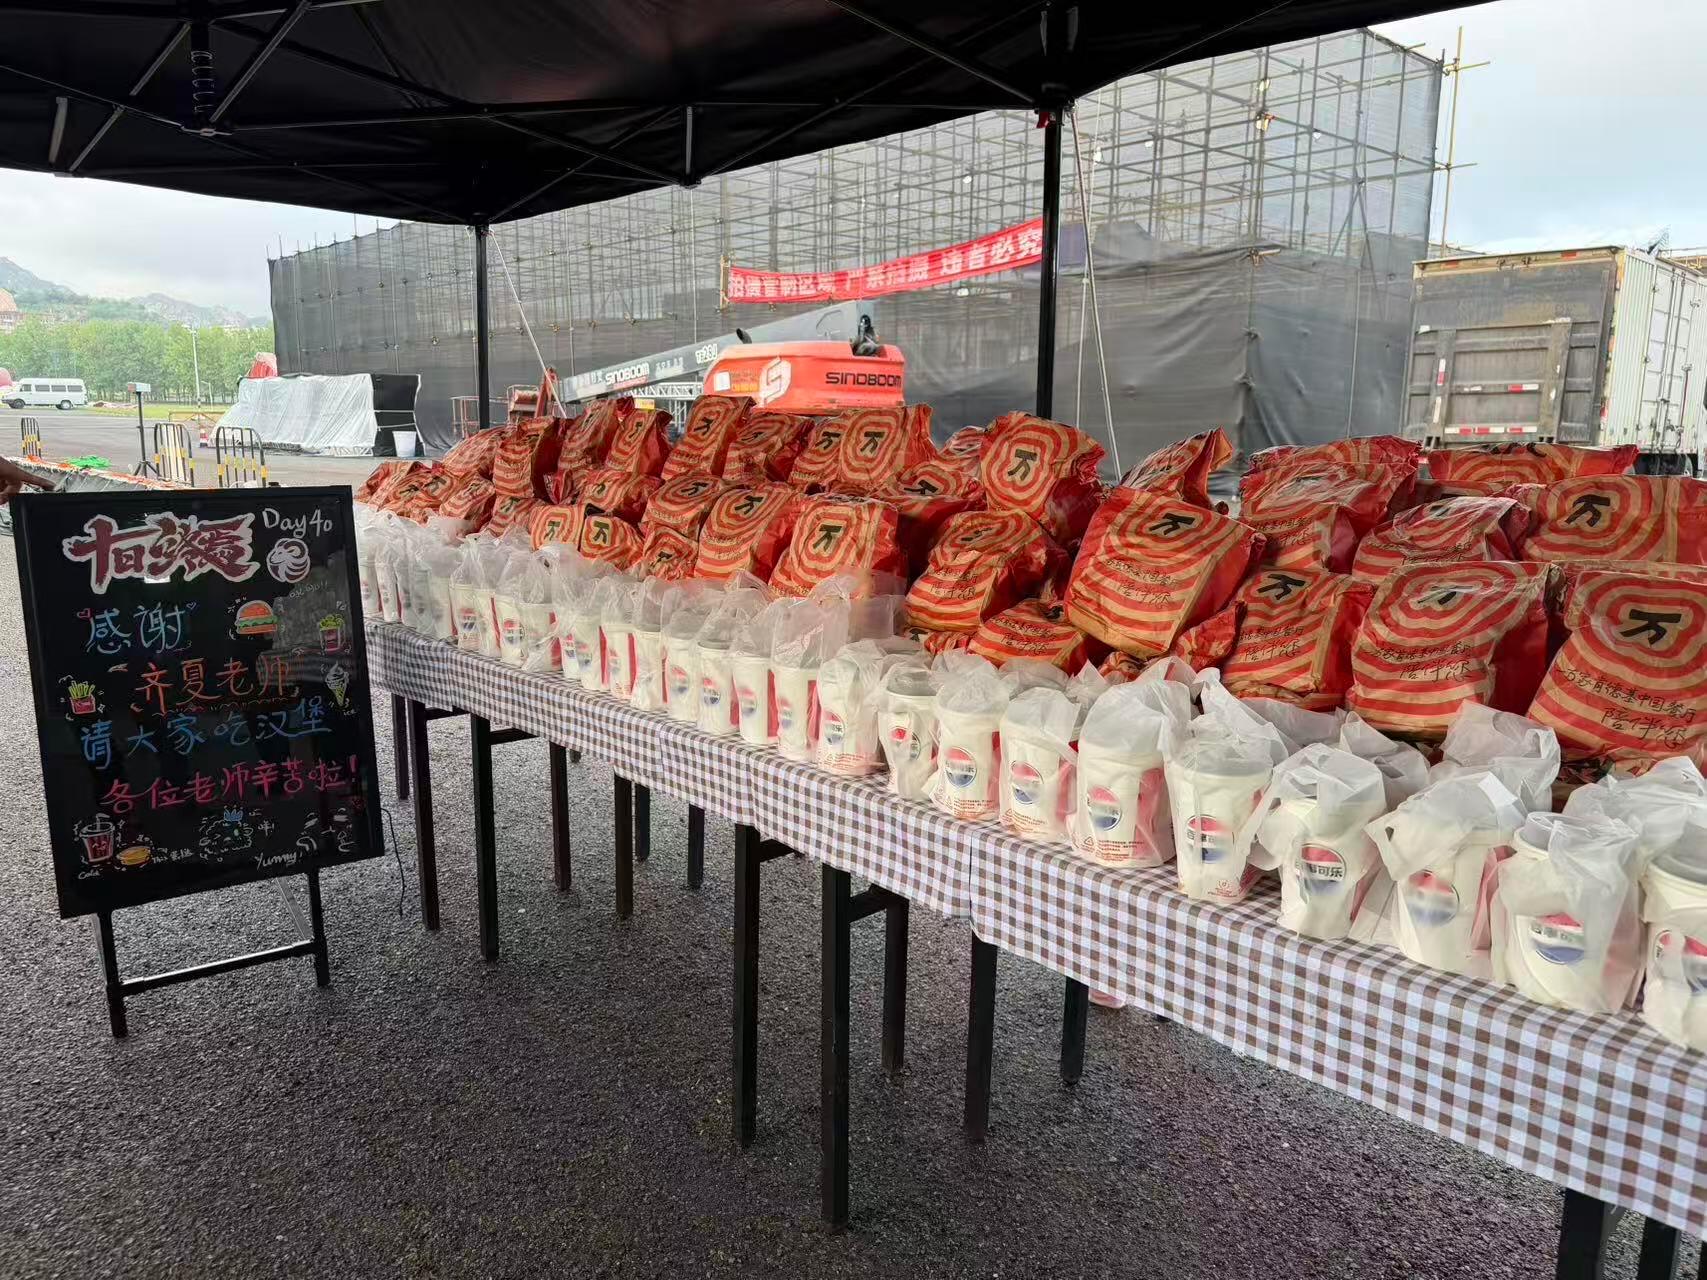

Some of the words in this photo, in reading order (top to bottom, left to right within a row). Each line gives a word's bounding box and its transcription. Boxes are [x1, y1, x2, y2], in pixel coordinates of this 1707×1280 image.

[940, 228, 1042, 275] 违者必究
[263, 508, 307, 538] Day
[309, 509, 333, 537] 40
[86, 601, 185, 653] 感谢
[135, 656, 289, 713] 齐夏老师
[81, 696, 332, 770] 请大家吃汉堡
